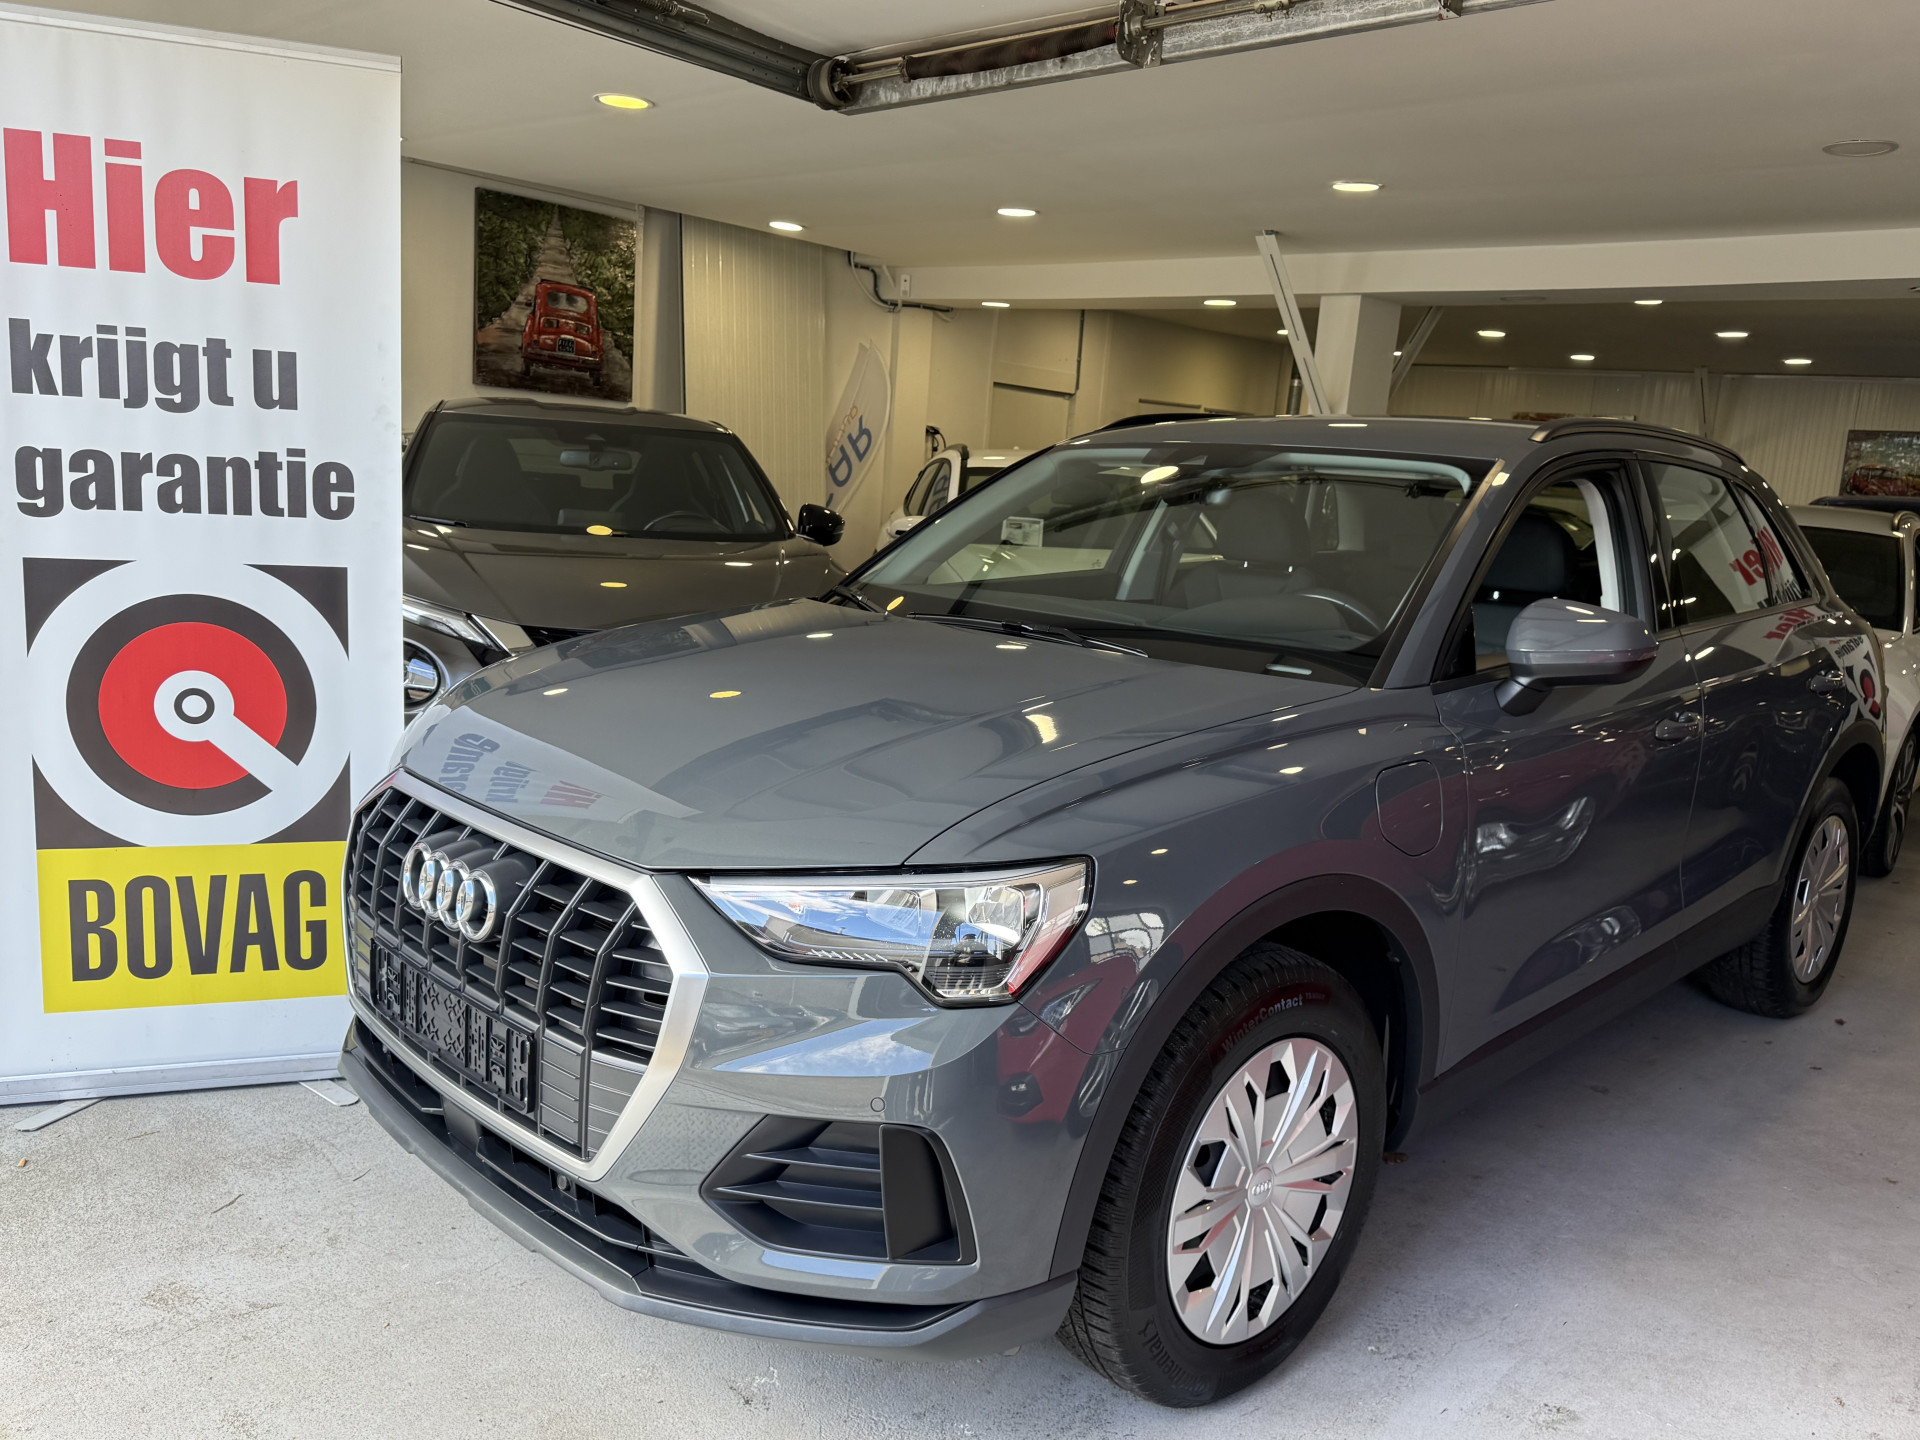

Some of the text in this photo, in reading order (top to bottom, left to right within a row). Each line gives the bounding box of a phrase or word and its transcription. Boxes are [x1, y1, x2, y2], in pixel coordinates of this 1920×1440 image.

[3, 127, 298, 285] Hier
[9, 317, 298, 413] krijgt u
[15, 445, 355, 521] garantie
[68, 870, 327, 981] BOVAG
[1221, 993, 1303, 1054] WinterContact
